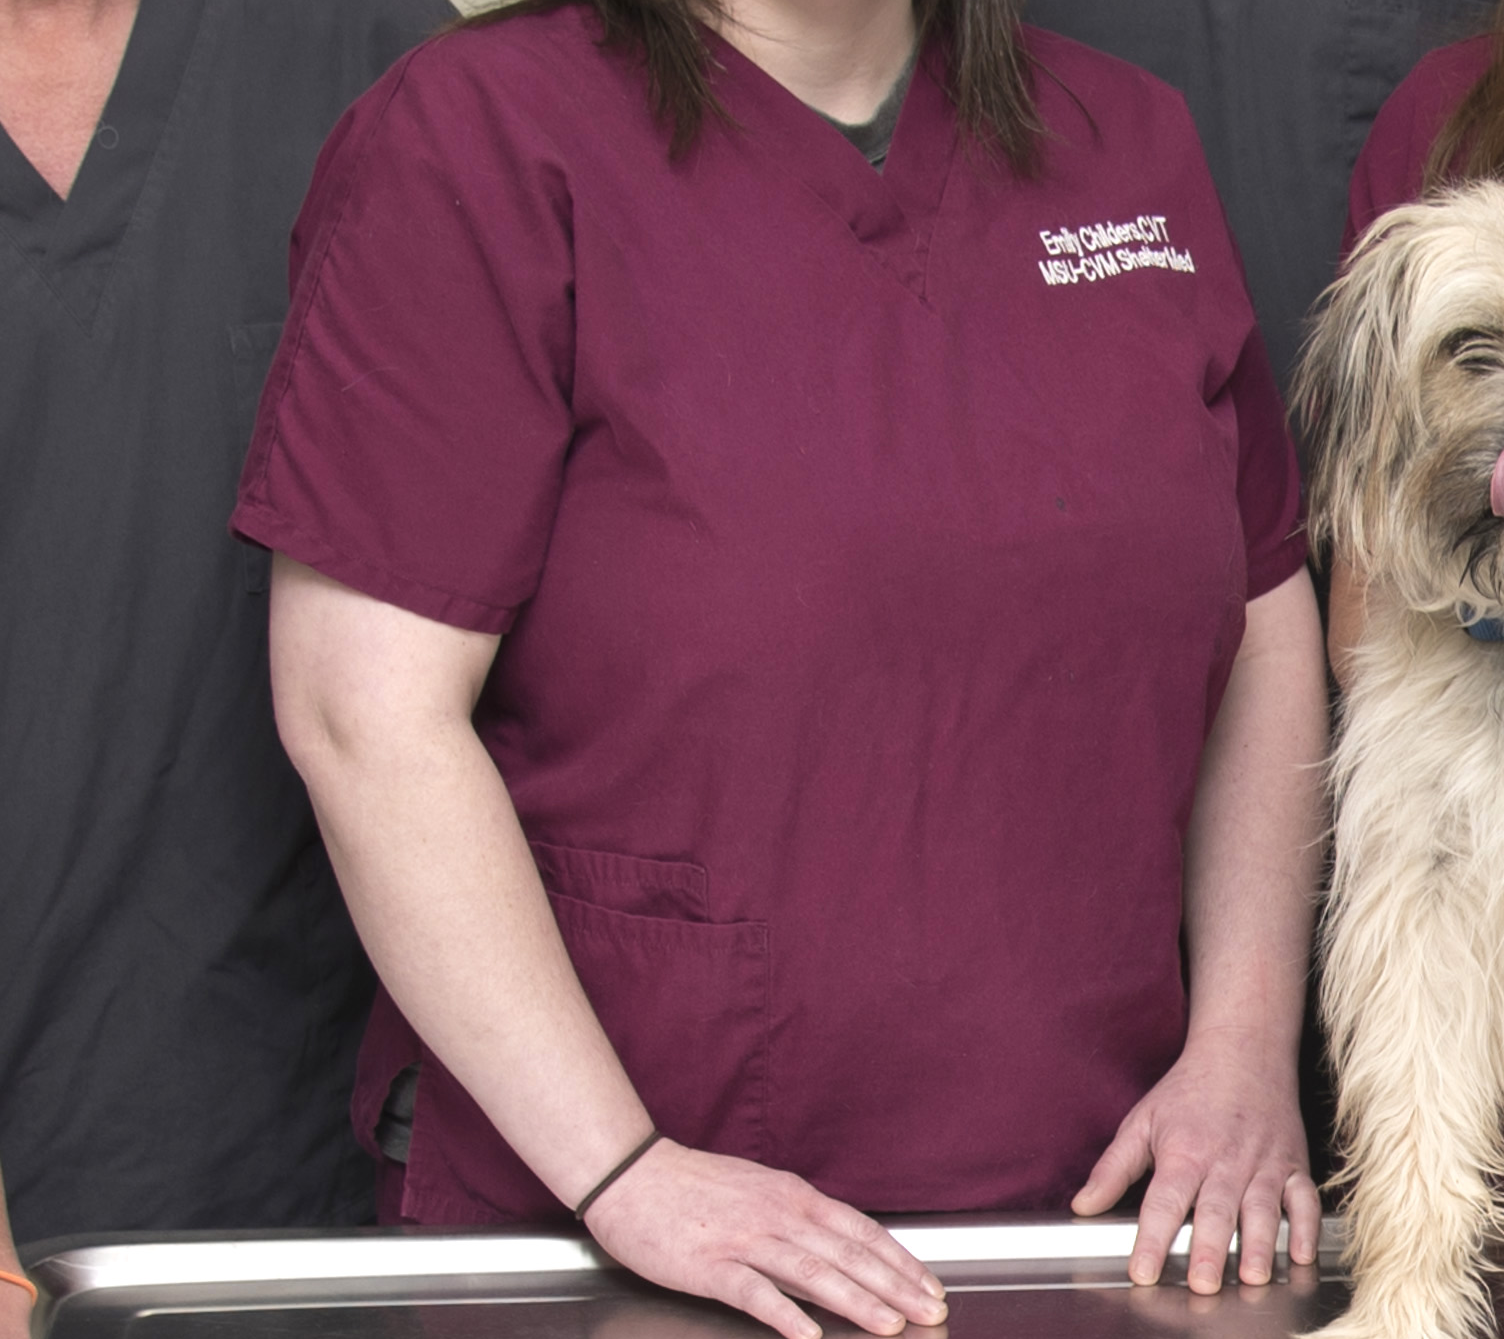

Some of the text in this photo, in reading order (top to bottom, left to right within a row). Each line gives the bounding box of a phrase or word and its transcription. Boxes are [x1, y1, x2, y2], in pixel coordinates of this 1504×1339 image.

[1039, 227, 1081, 257] Emily
[1038, 250, 1121, 286] MSU-CVM
[1118, 247, 1168, 273] Shelter
